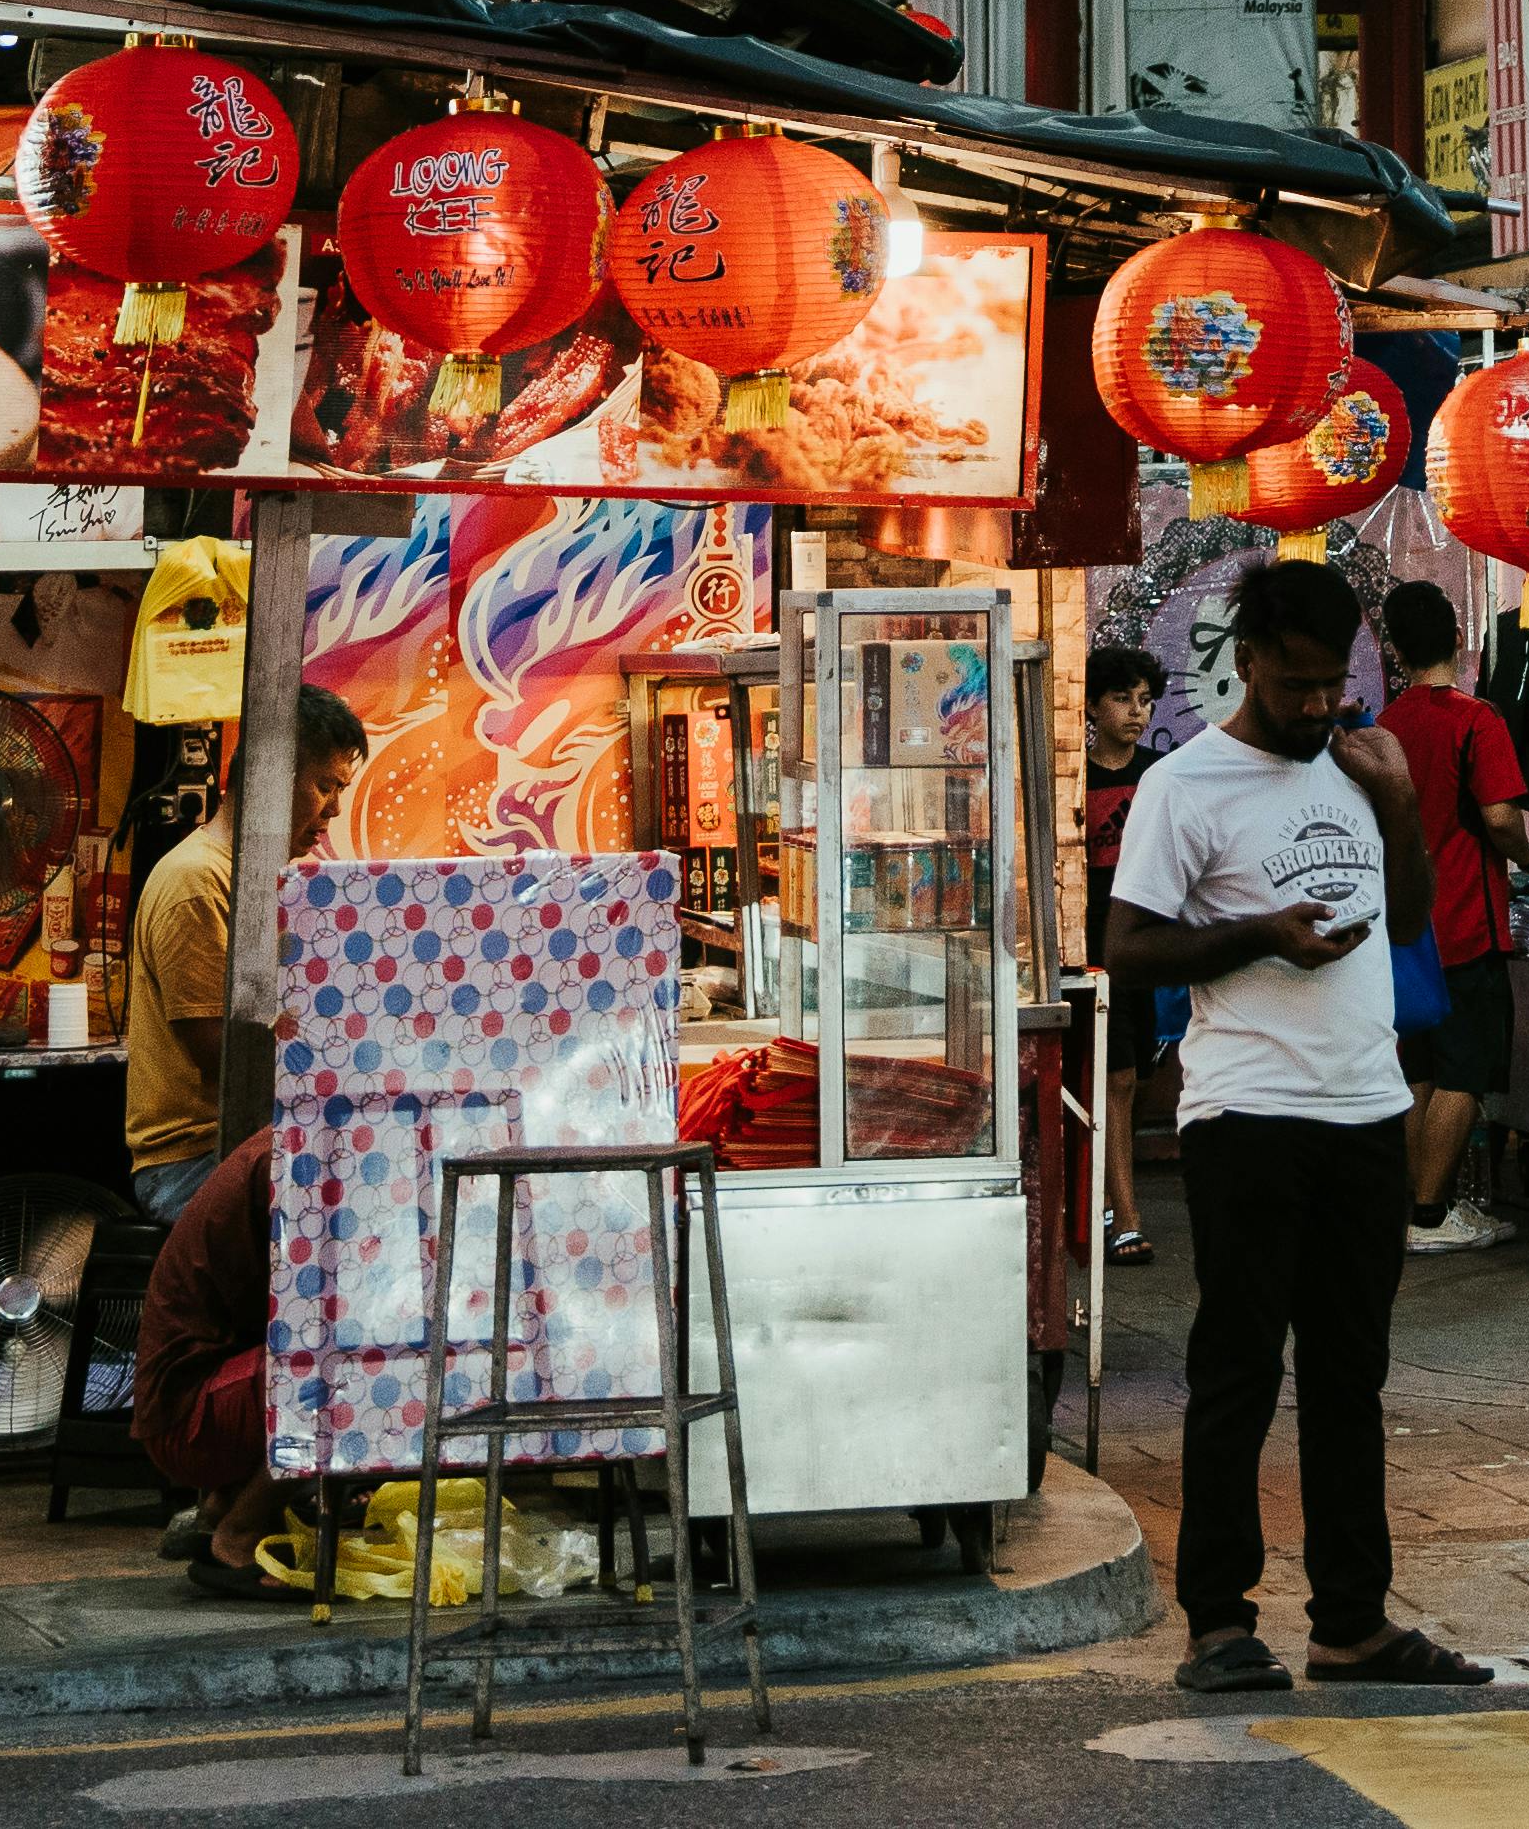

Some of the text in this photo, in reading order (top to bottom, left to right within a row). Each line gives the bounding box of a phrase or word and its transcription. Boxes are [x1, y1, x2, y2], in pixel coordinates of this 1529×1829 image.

[187, 74, 281, 188] 龍記
[389, 148, 510, 198] LOONG
[402, 194, 495, 236] KEE
[635, 173, 727, 285] 龍記
[701, 575, 737, 611] 行
[1261, 839, 1382, 889] BROOKLYN
